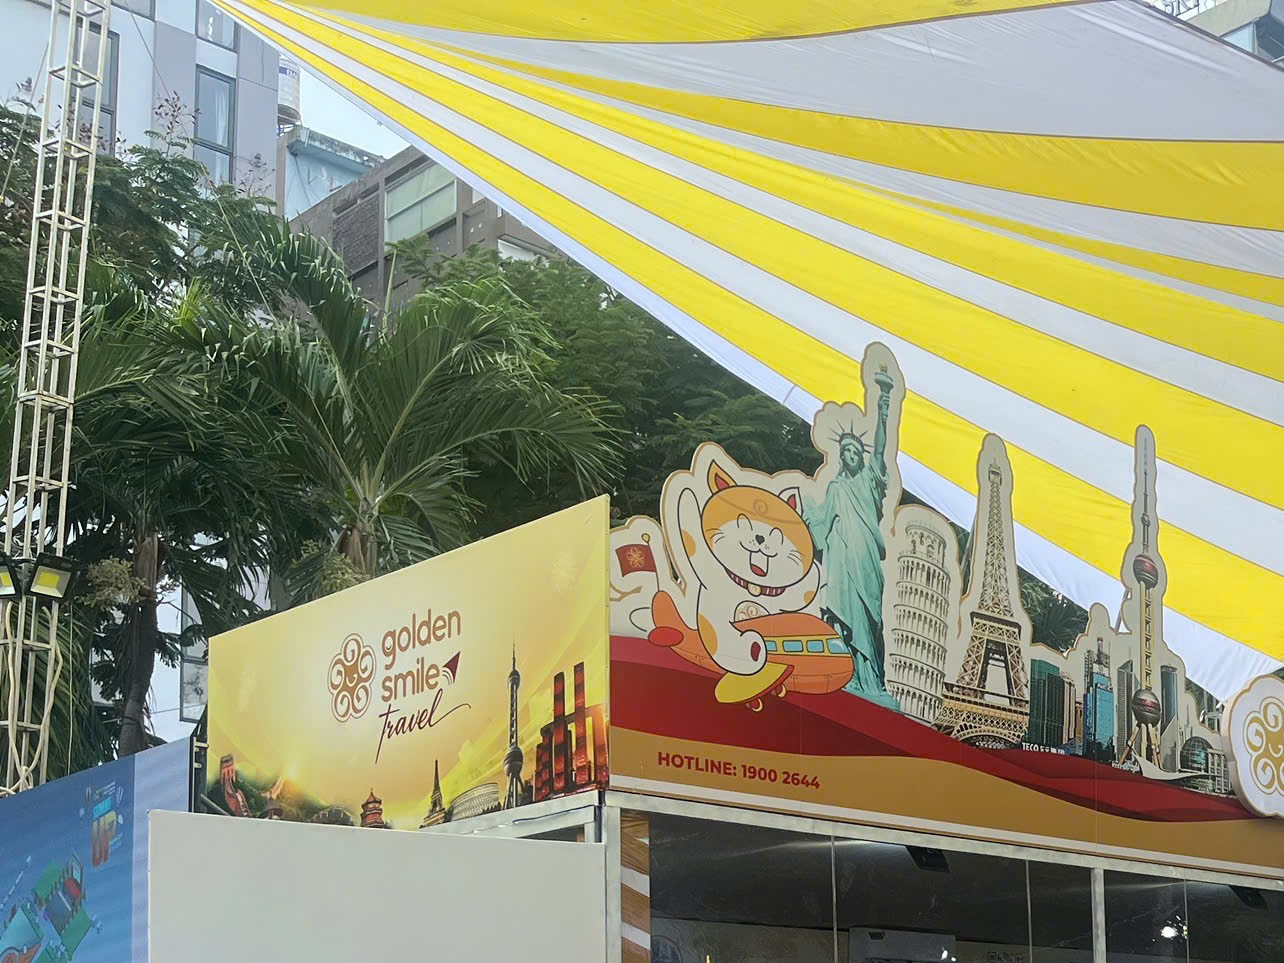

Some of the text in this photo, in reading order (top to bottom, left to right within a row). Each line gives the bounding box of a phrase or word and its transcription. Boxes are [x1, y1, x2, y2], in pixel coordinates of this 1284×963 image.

[381, 608, 461, 670] golden
[381, 657, 440, 702] smile
[658, 752, 820, 789] HOTLINE: 1900 2644
